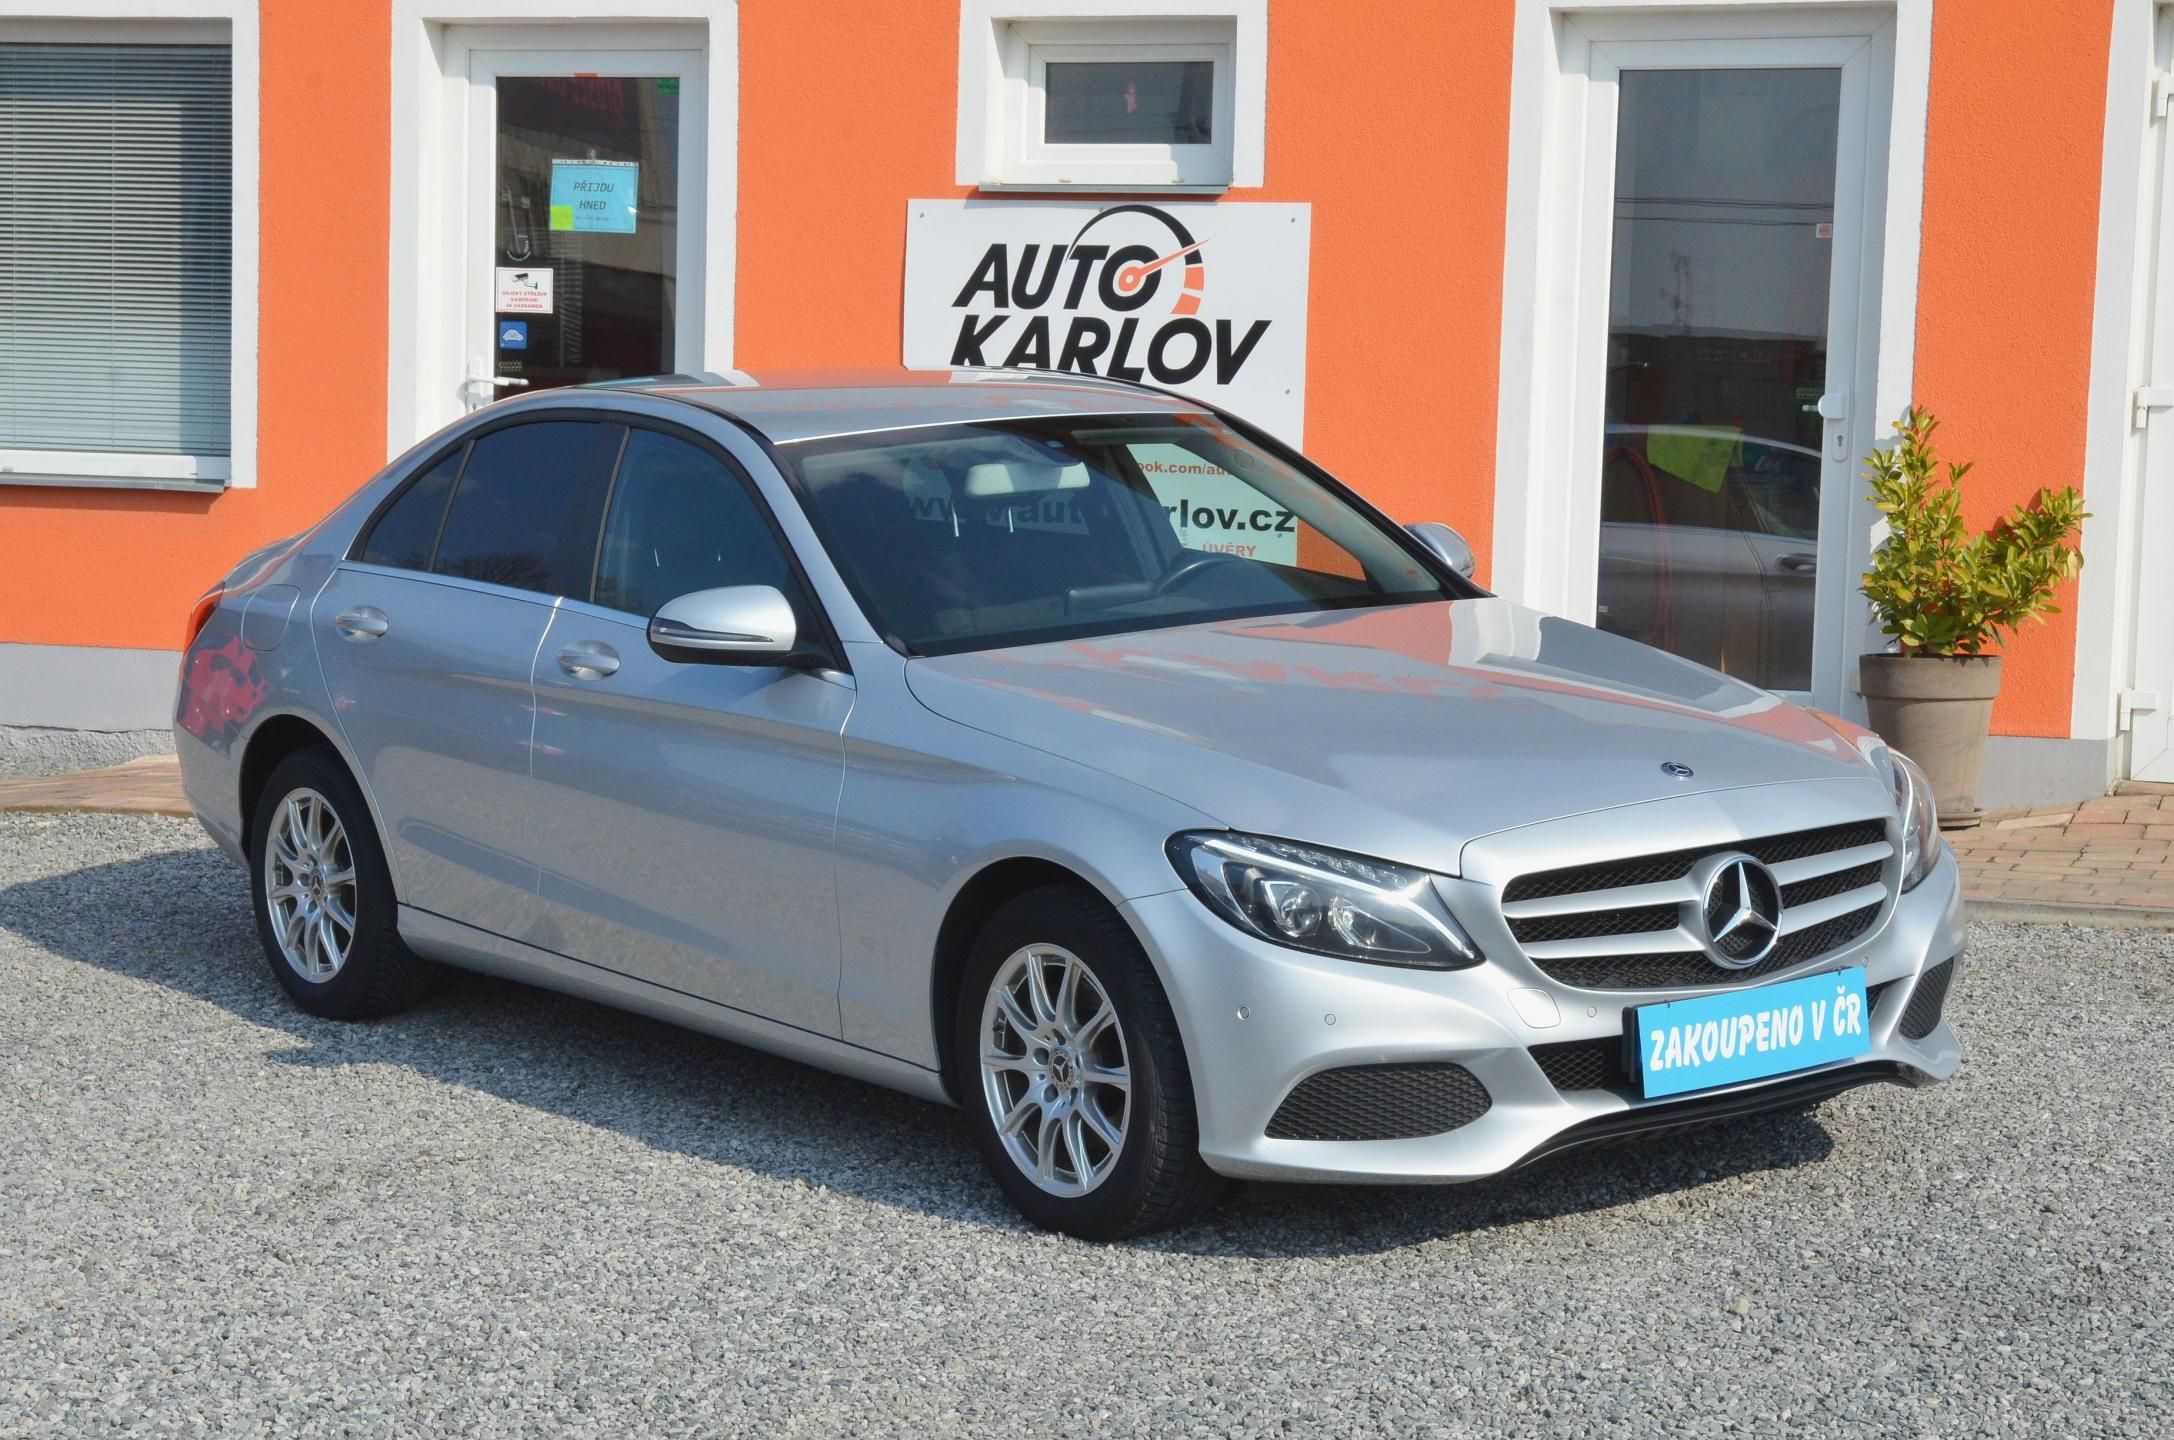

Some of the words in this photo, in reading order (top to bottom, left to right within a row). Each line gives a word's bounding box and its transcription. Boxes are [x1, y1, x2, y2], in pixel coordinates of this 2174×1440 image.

[573, 180, 615, 193] PŘIJDU
[579, 200, 607, 210] HNED
[952, 243, 1162, 311] AUTO
[949, 315, 1272, 385] KARLOV
[1649, 1004, 1804, 1072] ZAKOUPENO
[1811, 999, 1826, 1041] V
[1832, 984, 1862, 1037] ČR
